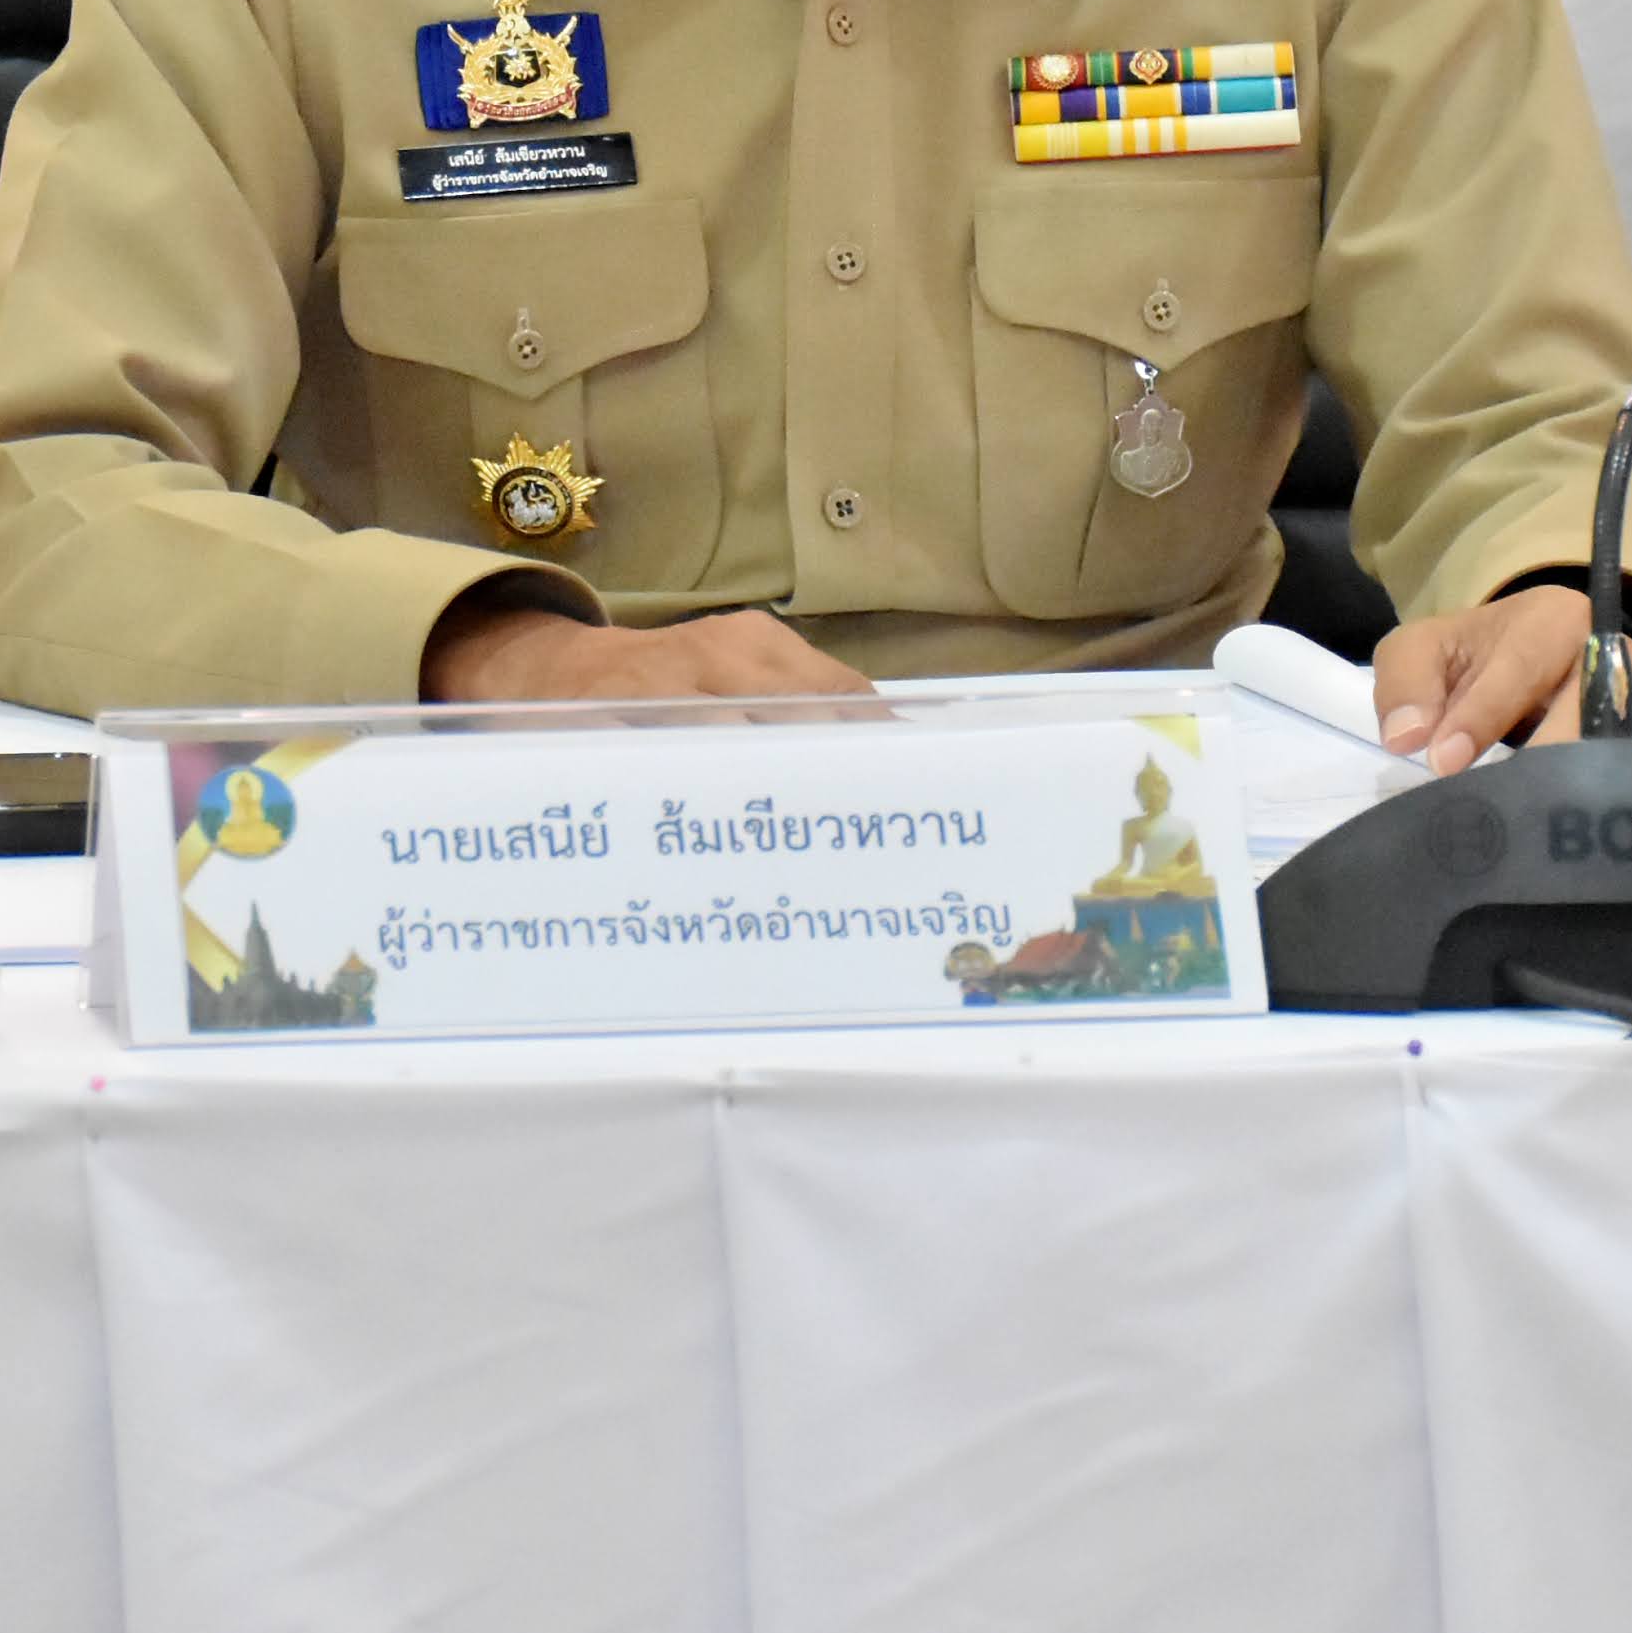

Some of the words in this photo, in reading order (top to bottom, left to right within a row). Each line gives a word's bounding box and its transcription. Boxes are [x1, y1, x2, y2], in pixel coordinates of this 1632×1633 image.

[382, 801, 609, 864] นายเสนีย์
[654, 797, 986, 855] ส้มเขียวหวาน
[378, 891, 1012, 970] ผู้ว่าราชการจังหวัดอำนาจเจริญ
